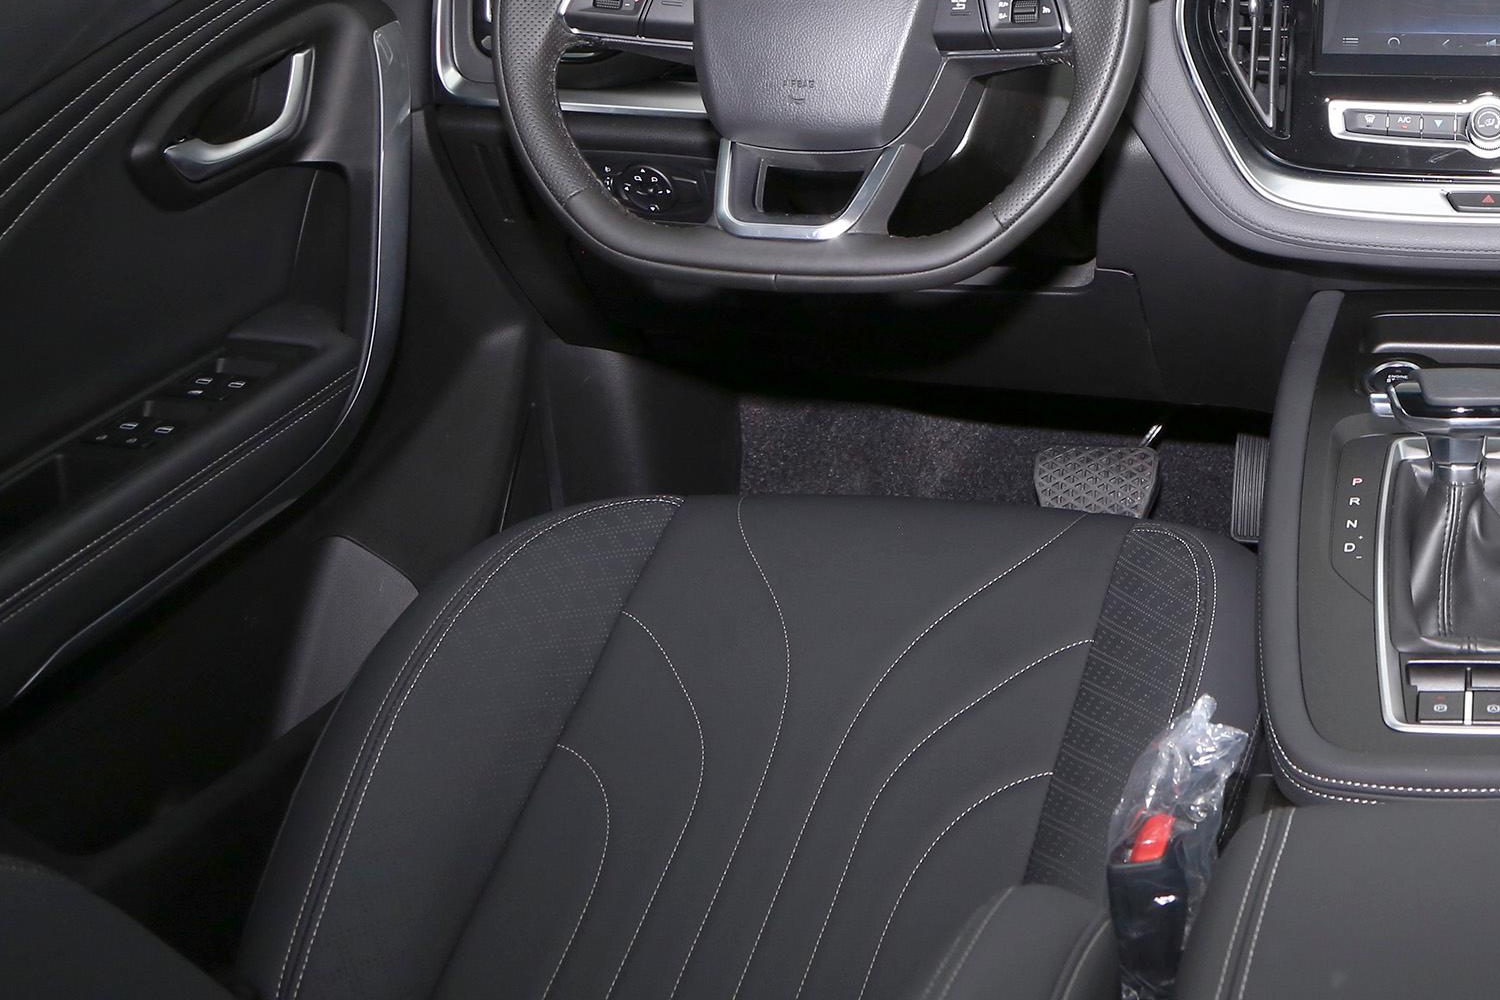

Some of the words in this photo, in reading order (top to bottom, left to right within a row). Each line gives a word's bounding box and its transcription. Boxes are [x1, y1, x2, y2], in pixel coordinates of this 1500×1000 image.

[1397, 116, 1411, 124] A/C
[1352, 477, 1363, 486] P
[1349, 497, 1361, 506] R
[1346, 520, 1358, 528] N
[1344, 543, 1356, 552] D
